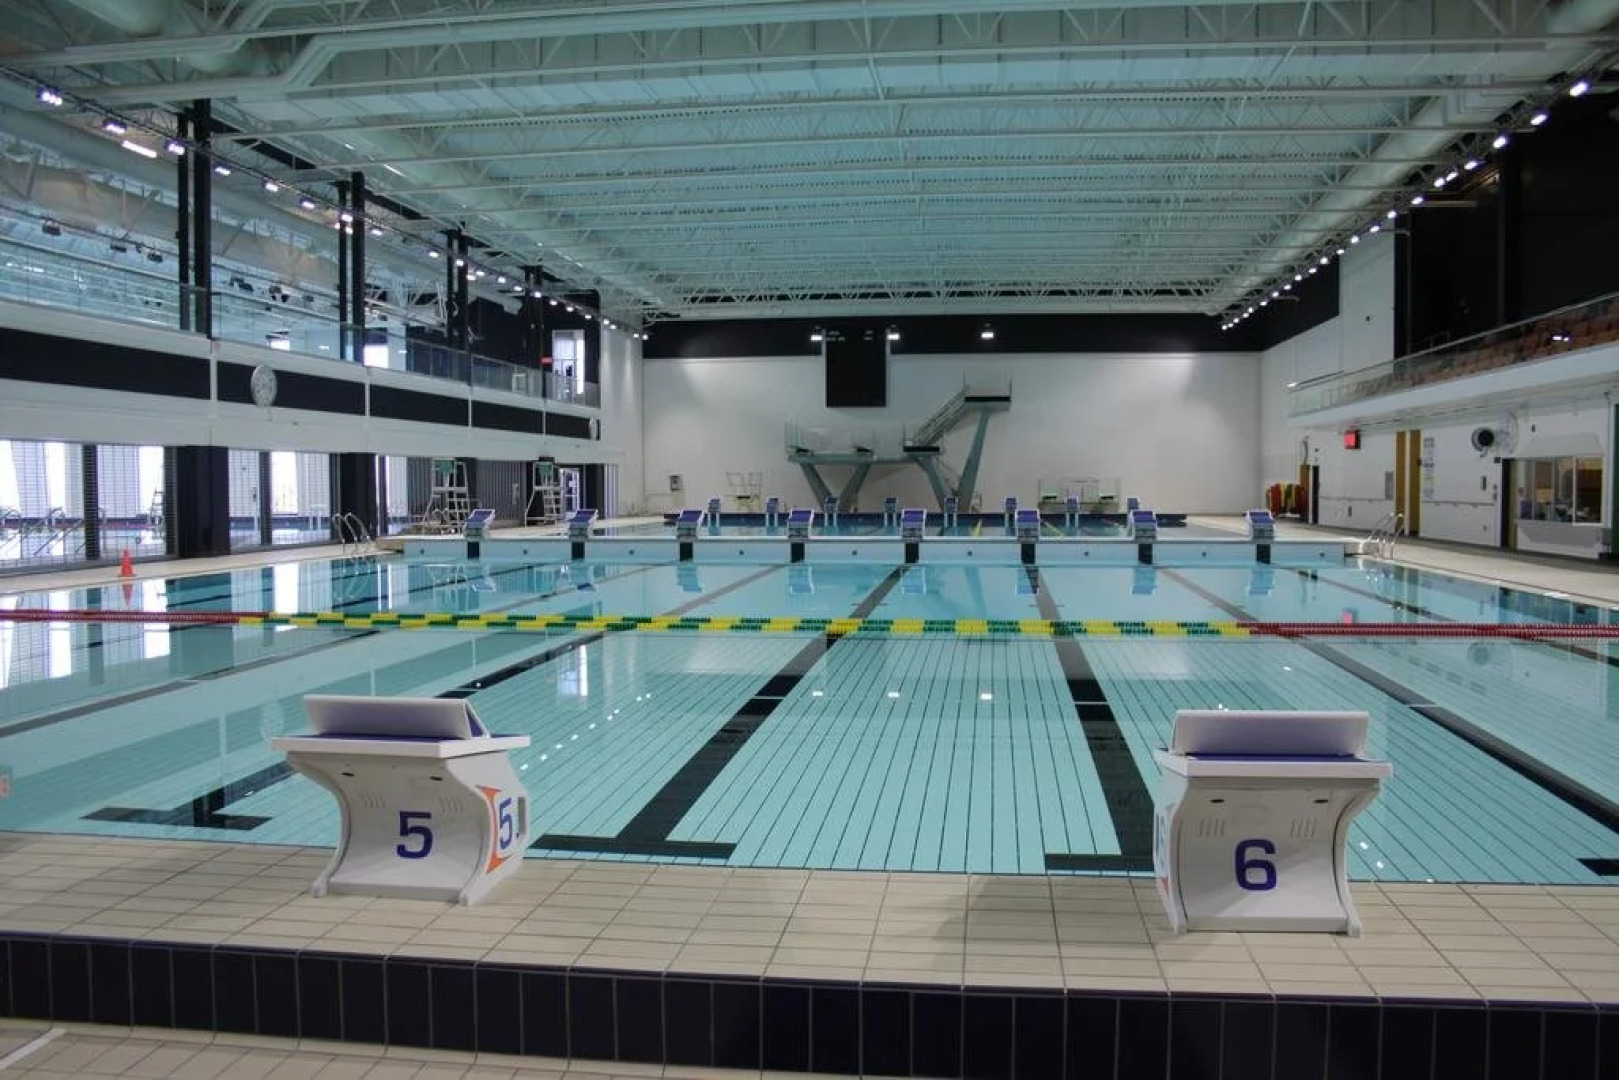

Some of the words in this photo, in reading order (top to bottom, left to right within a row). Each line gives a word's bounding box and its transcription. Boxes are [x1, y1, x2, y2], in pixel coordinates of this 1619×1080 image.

[396, 810, 433, 859] 5
[499, 797, 513, 850] 5
[1234, 838, 1277, 891] 6
